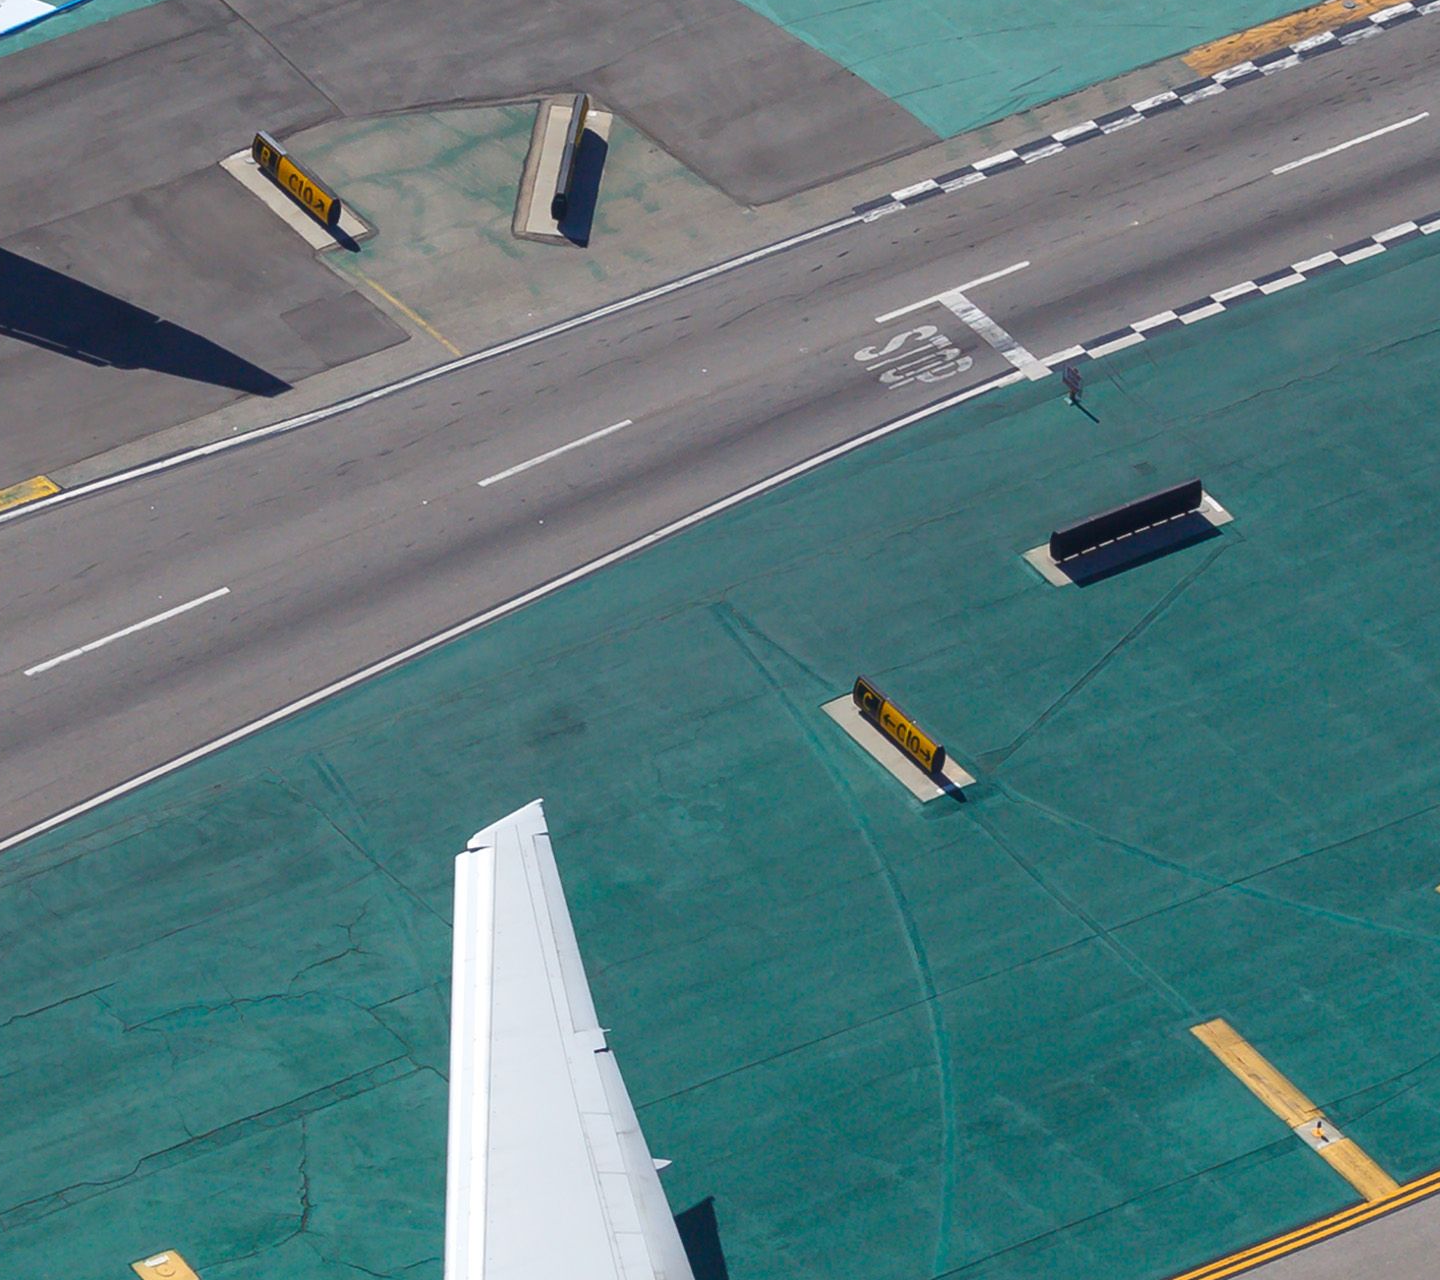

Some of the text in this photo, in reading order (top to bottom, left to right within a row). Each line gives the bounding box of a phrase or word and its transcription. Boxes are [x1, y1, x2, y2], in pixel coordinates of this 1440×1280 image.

[288, 173, 315, 206] C10
[854, 325, 974, 390] STOP
[863, 691, 921, 754] C C10
